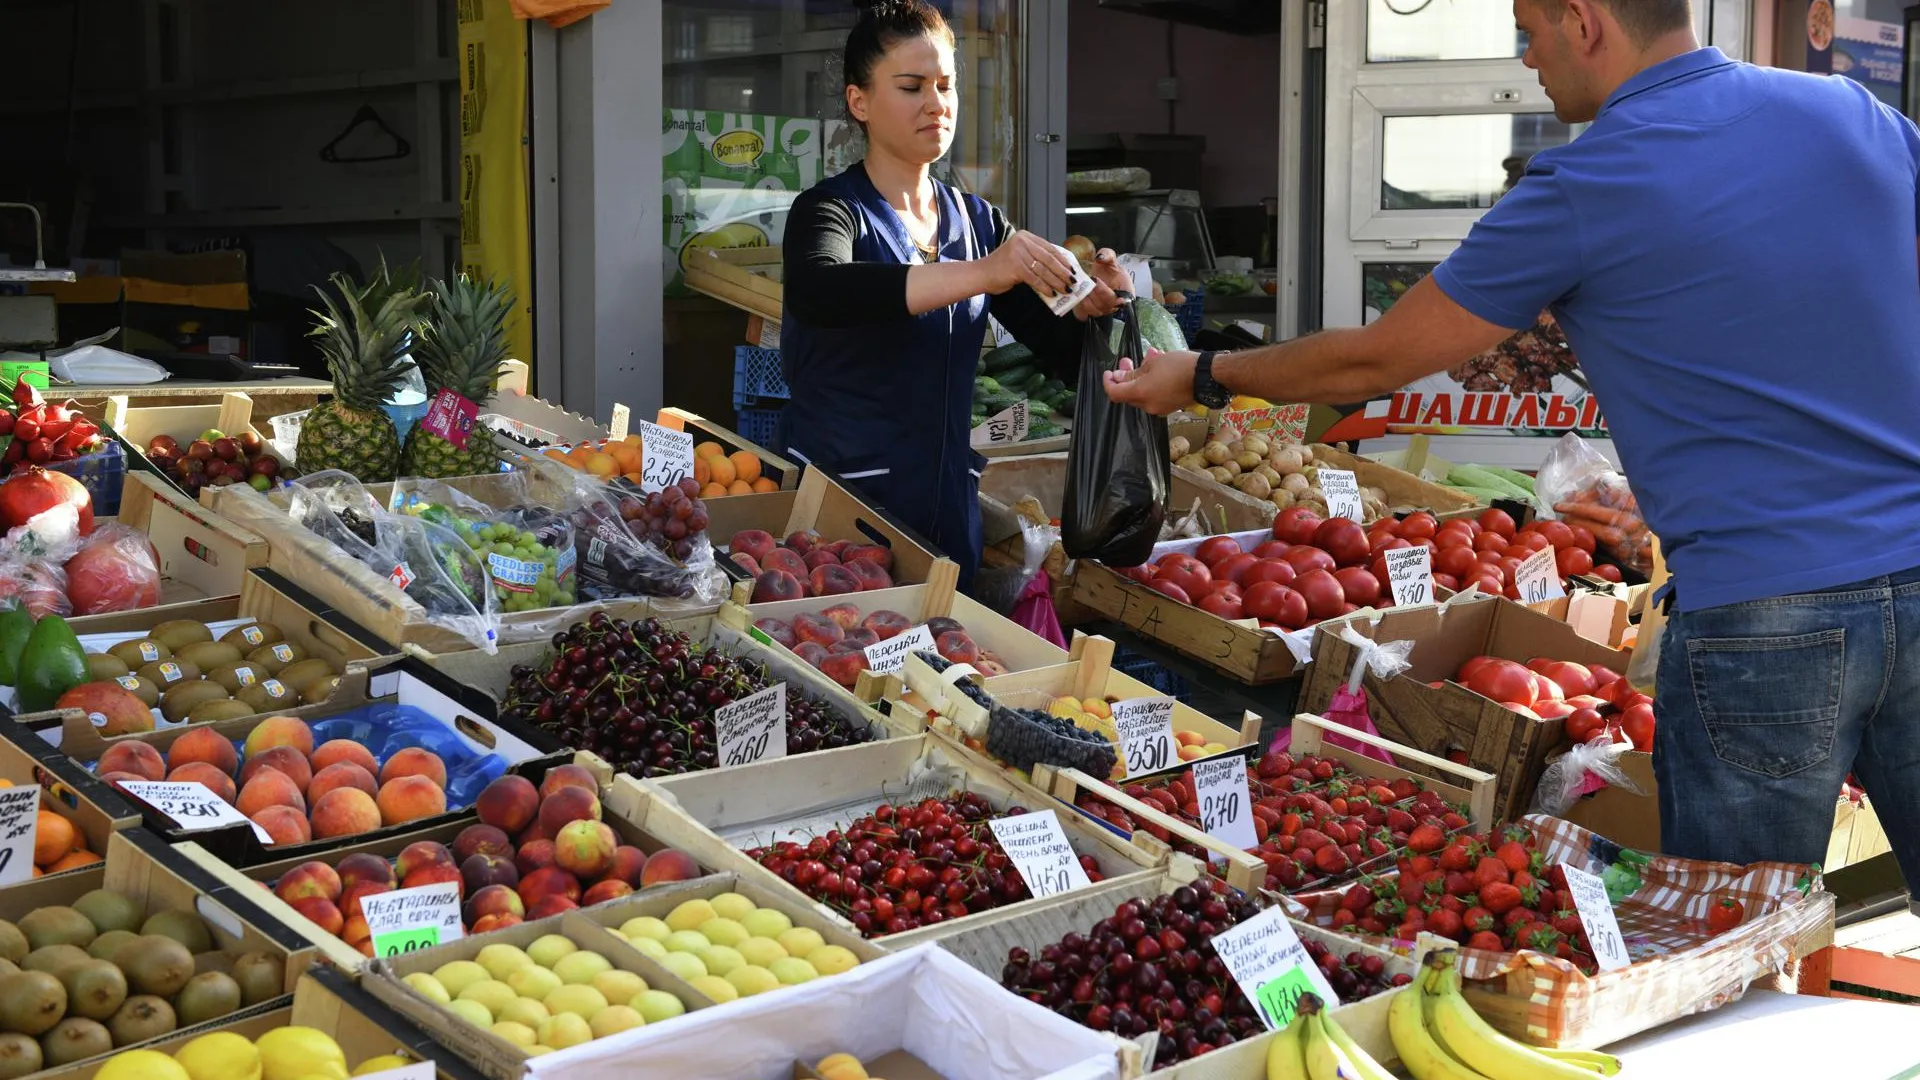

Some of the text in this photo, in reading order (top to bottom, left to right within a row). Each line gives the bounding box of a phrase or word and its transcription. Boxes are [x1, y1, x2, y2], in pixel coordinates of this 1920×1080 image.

[663, 117, 705, 133] onanza!
[716, 139, 760, 159] Bonanza!
[1387, 392, 1609, 430] ШАШЛЫ
[987, 420, 1009, 441] 120
[643, 457, 686, 487] 250
[1335, 502, 1354, 520] 120
[489, 553, 545, 573] SEEDLESS
[493, 565, 538, 584] GRAPES
[1398, 582, 1425, 605] 350
[1527, 577, 1547, 604] 160
[869, 634, 921, 660] ПЕРСИКИ
[717, 691, 778, 721] ЧЕРЕШНЯ
[726, 732, 769, 766] 360
[1128, 735, 1169, 772] 350
[162, 800, 221, 818] 280
[1204, 792, 1239, 834] 270
[994, 820, 1049, 838] ЧЕРЕШНЯ
[1027, 864, 1071, 897] 450
[367, 892, 458, 915] НЕКТАРИНЫ
[1217, 918, 1283, 957] ЧЕРЕШНЯ
[1586, 919, 1619, 960] 250
